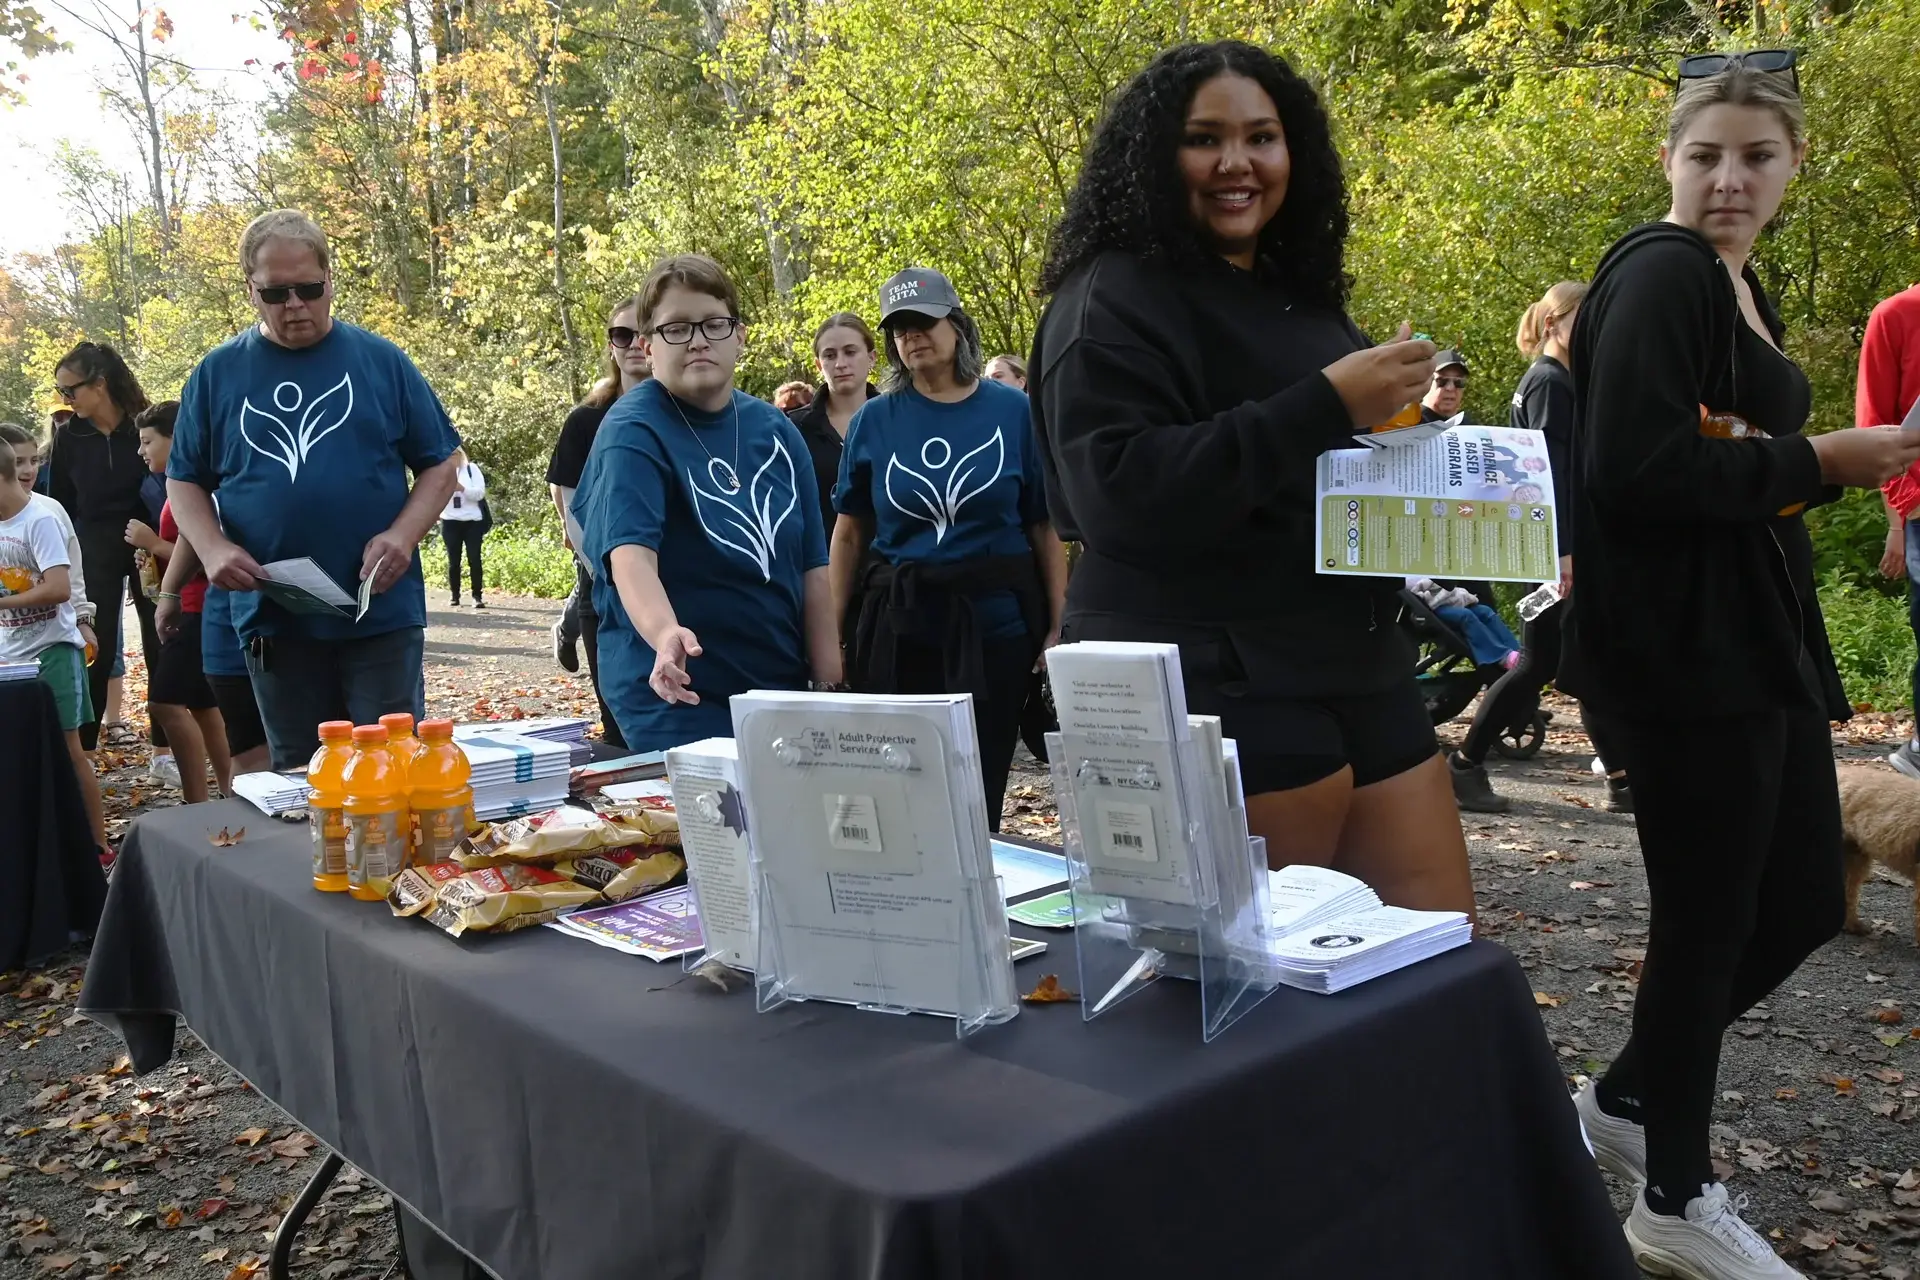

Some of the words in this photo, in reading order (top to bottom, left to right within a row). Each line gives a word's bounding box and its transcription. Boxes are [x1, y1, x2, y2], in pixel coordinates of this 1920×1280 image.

[888, 280, 919, 296] TEAM
[888, 288, 918, 304] RITA
[1446, 431, 1463, 487] PROGRAMS
[1464, 441, 1480, 474] BASED
[1480, 437, 1498, 484] EVIDENCE
[838, 732, 865, 743] Adult
[866, 733, 917, 745] Protective
[839, 744, 881, 755] Services
[650, 934, 685, 946] Save
